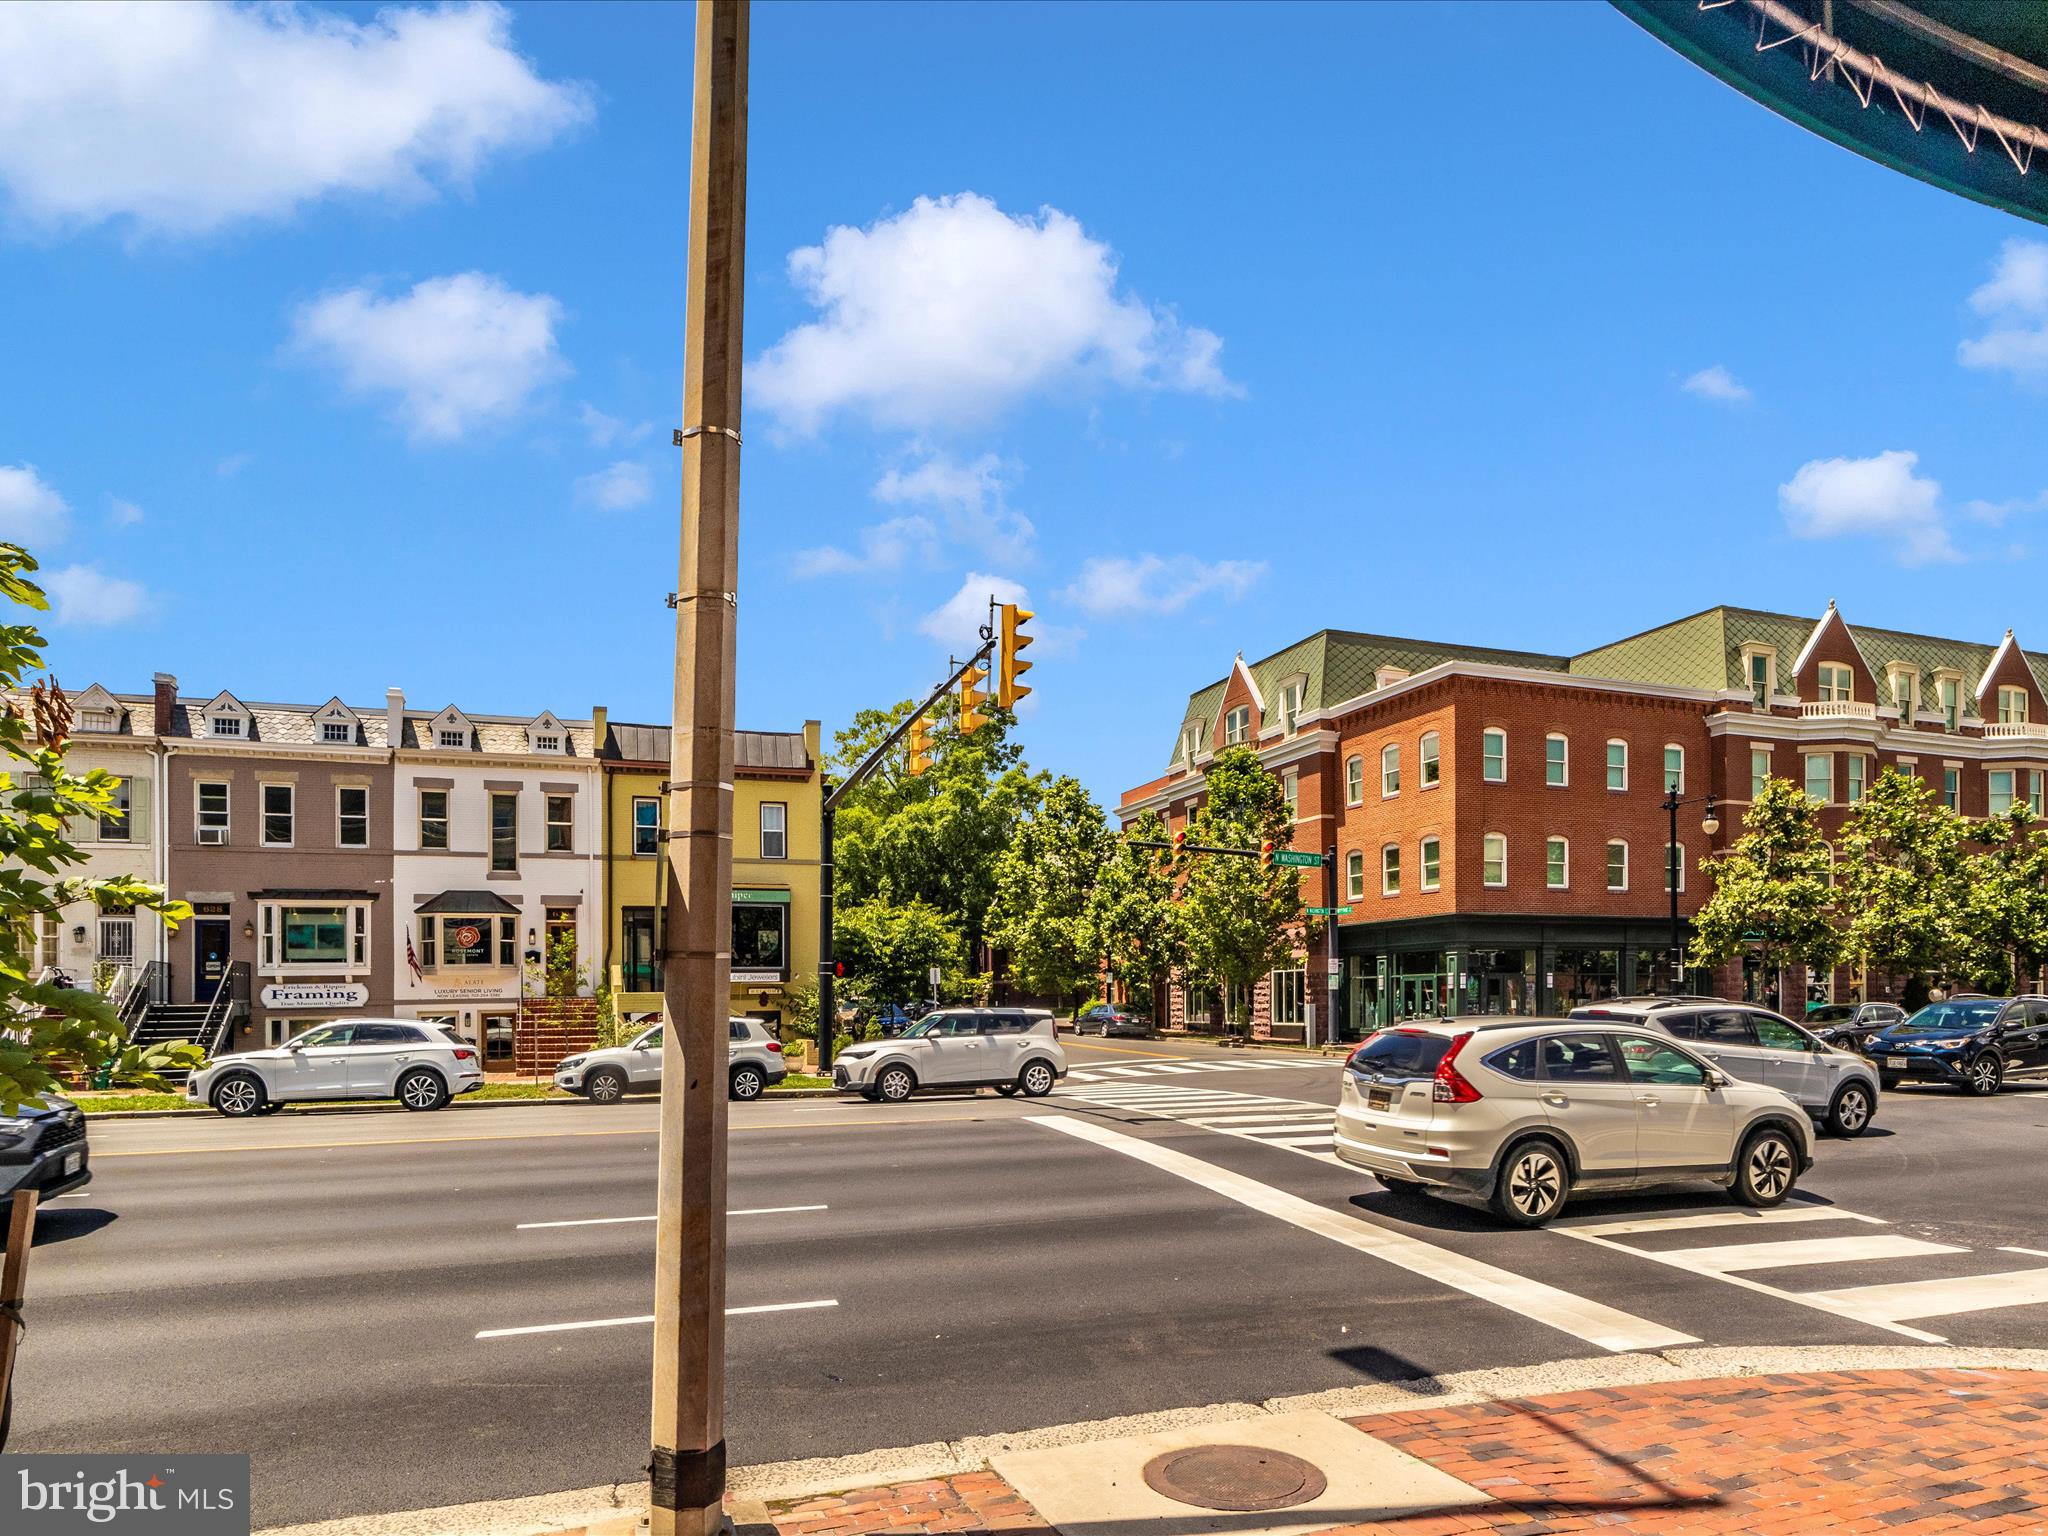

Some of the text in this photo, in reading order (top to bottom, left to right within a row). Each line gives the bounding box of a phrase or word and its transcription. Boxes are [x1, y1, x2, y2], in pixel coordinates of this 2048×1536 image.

[1275, 853, 1320, 865] N WASHINGTON ST
[203, 905, 223, 913] 628
[271, 989, 358, 1001] Framing
